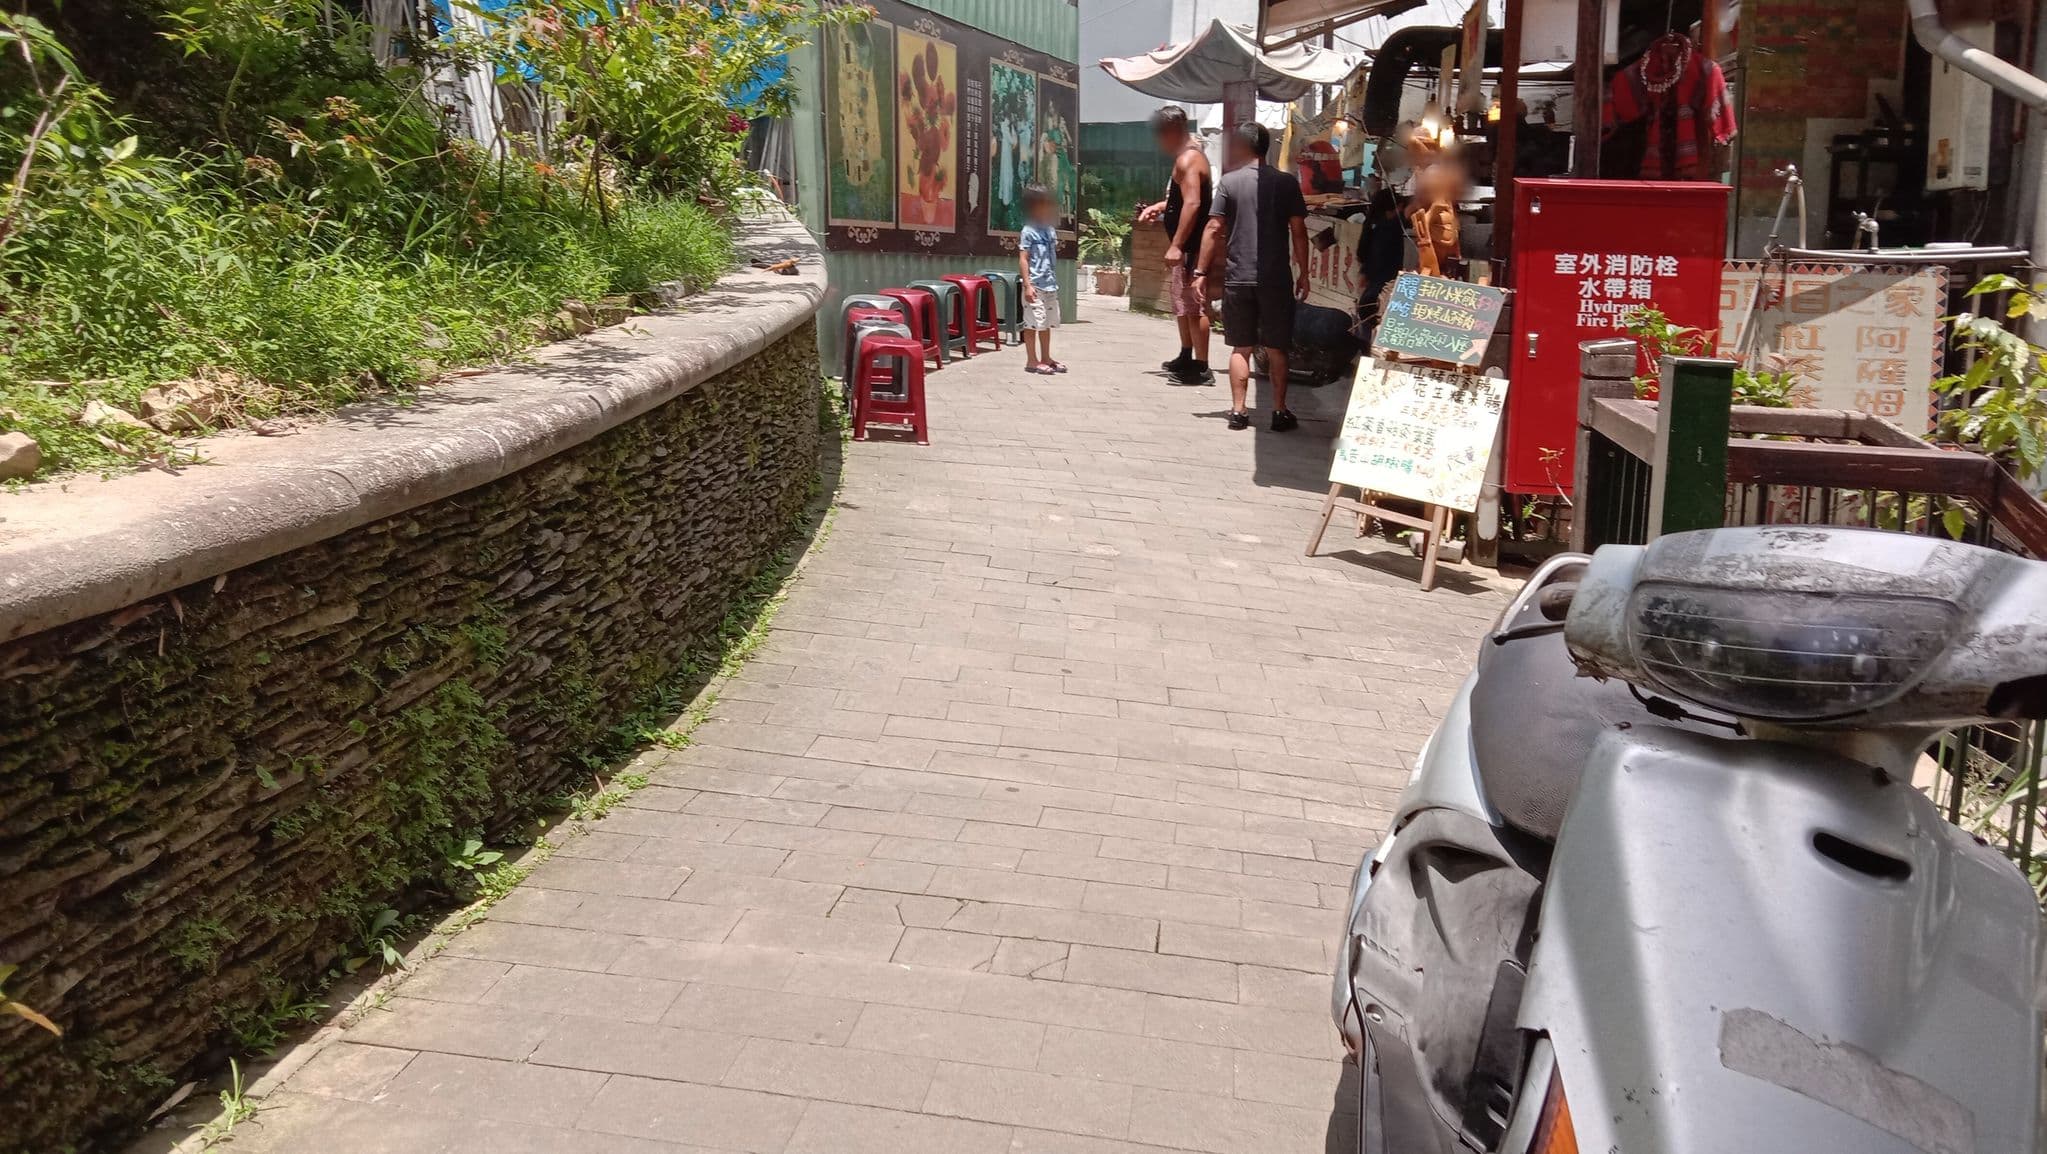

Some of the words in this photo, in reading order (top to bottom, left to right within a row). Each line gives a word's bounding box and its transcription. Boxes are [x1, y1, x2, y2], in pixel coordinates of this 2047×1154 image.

[1554, 253, 1680, 277] 室外消防栓
[1578, 277, 1652, 300] 水帶箱
[1576, 313, 1609, 327] Fire
[1856, 325, 1910, 426] 阿薩姆
